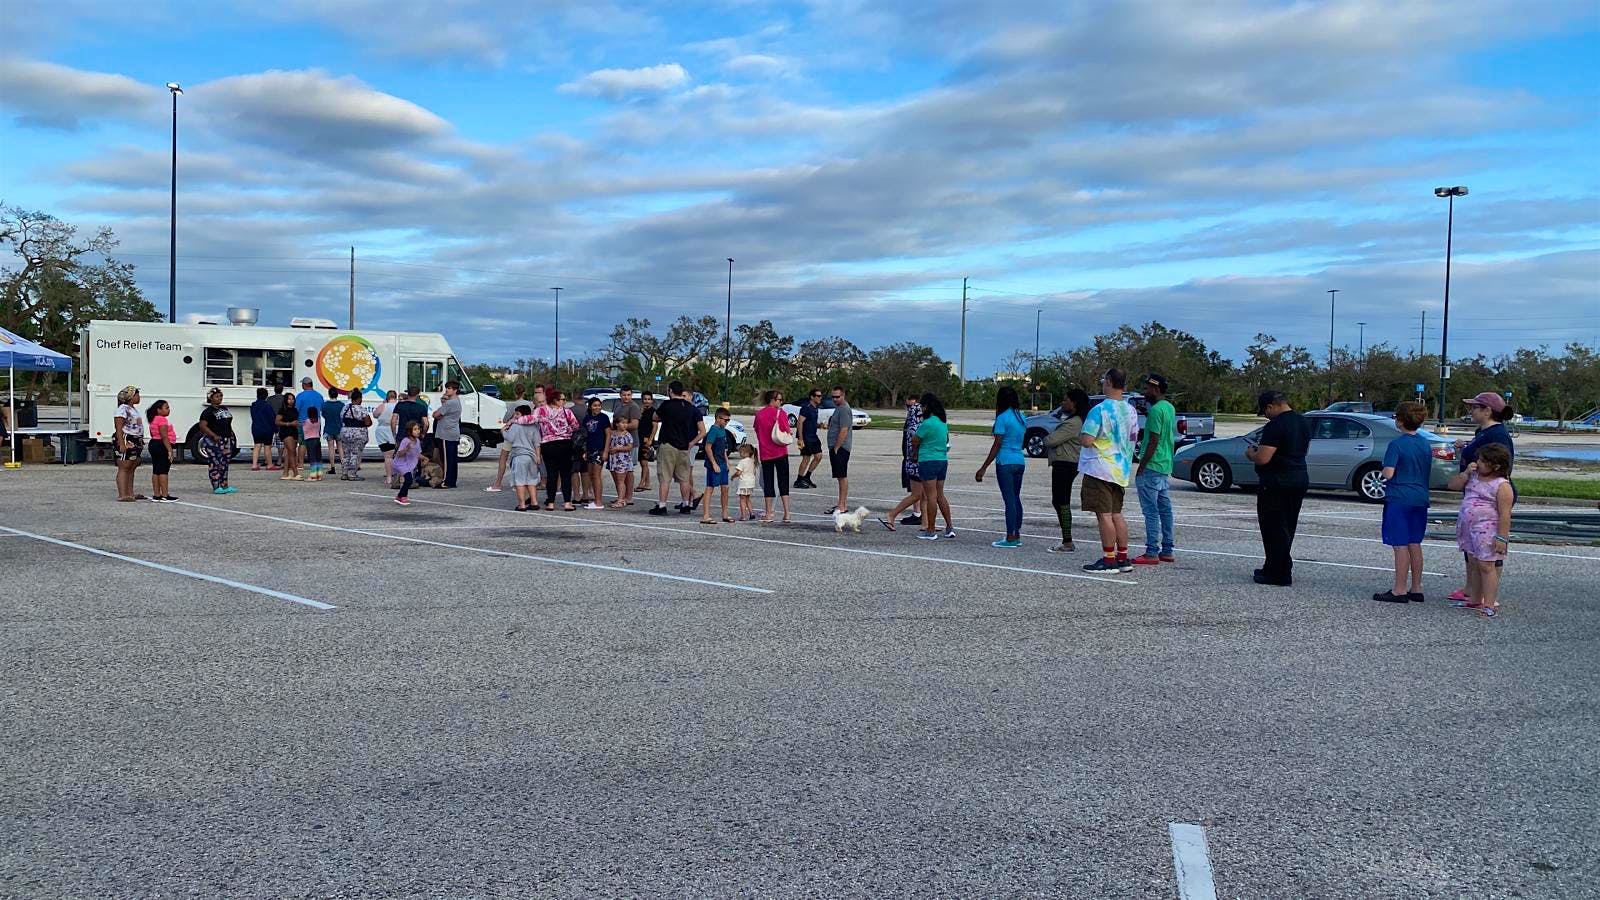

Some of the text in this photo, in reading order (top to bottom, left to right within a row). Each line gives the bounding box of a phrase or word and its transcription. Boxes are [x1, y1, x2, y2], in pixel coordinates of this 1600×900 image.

[96, 339, 182, 351] Chef Relief Team
